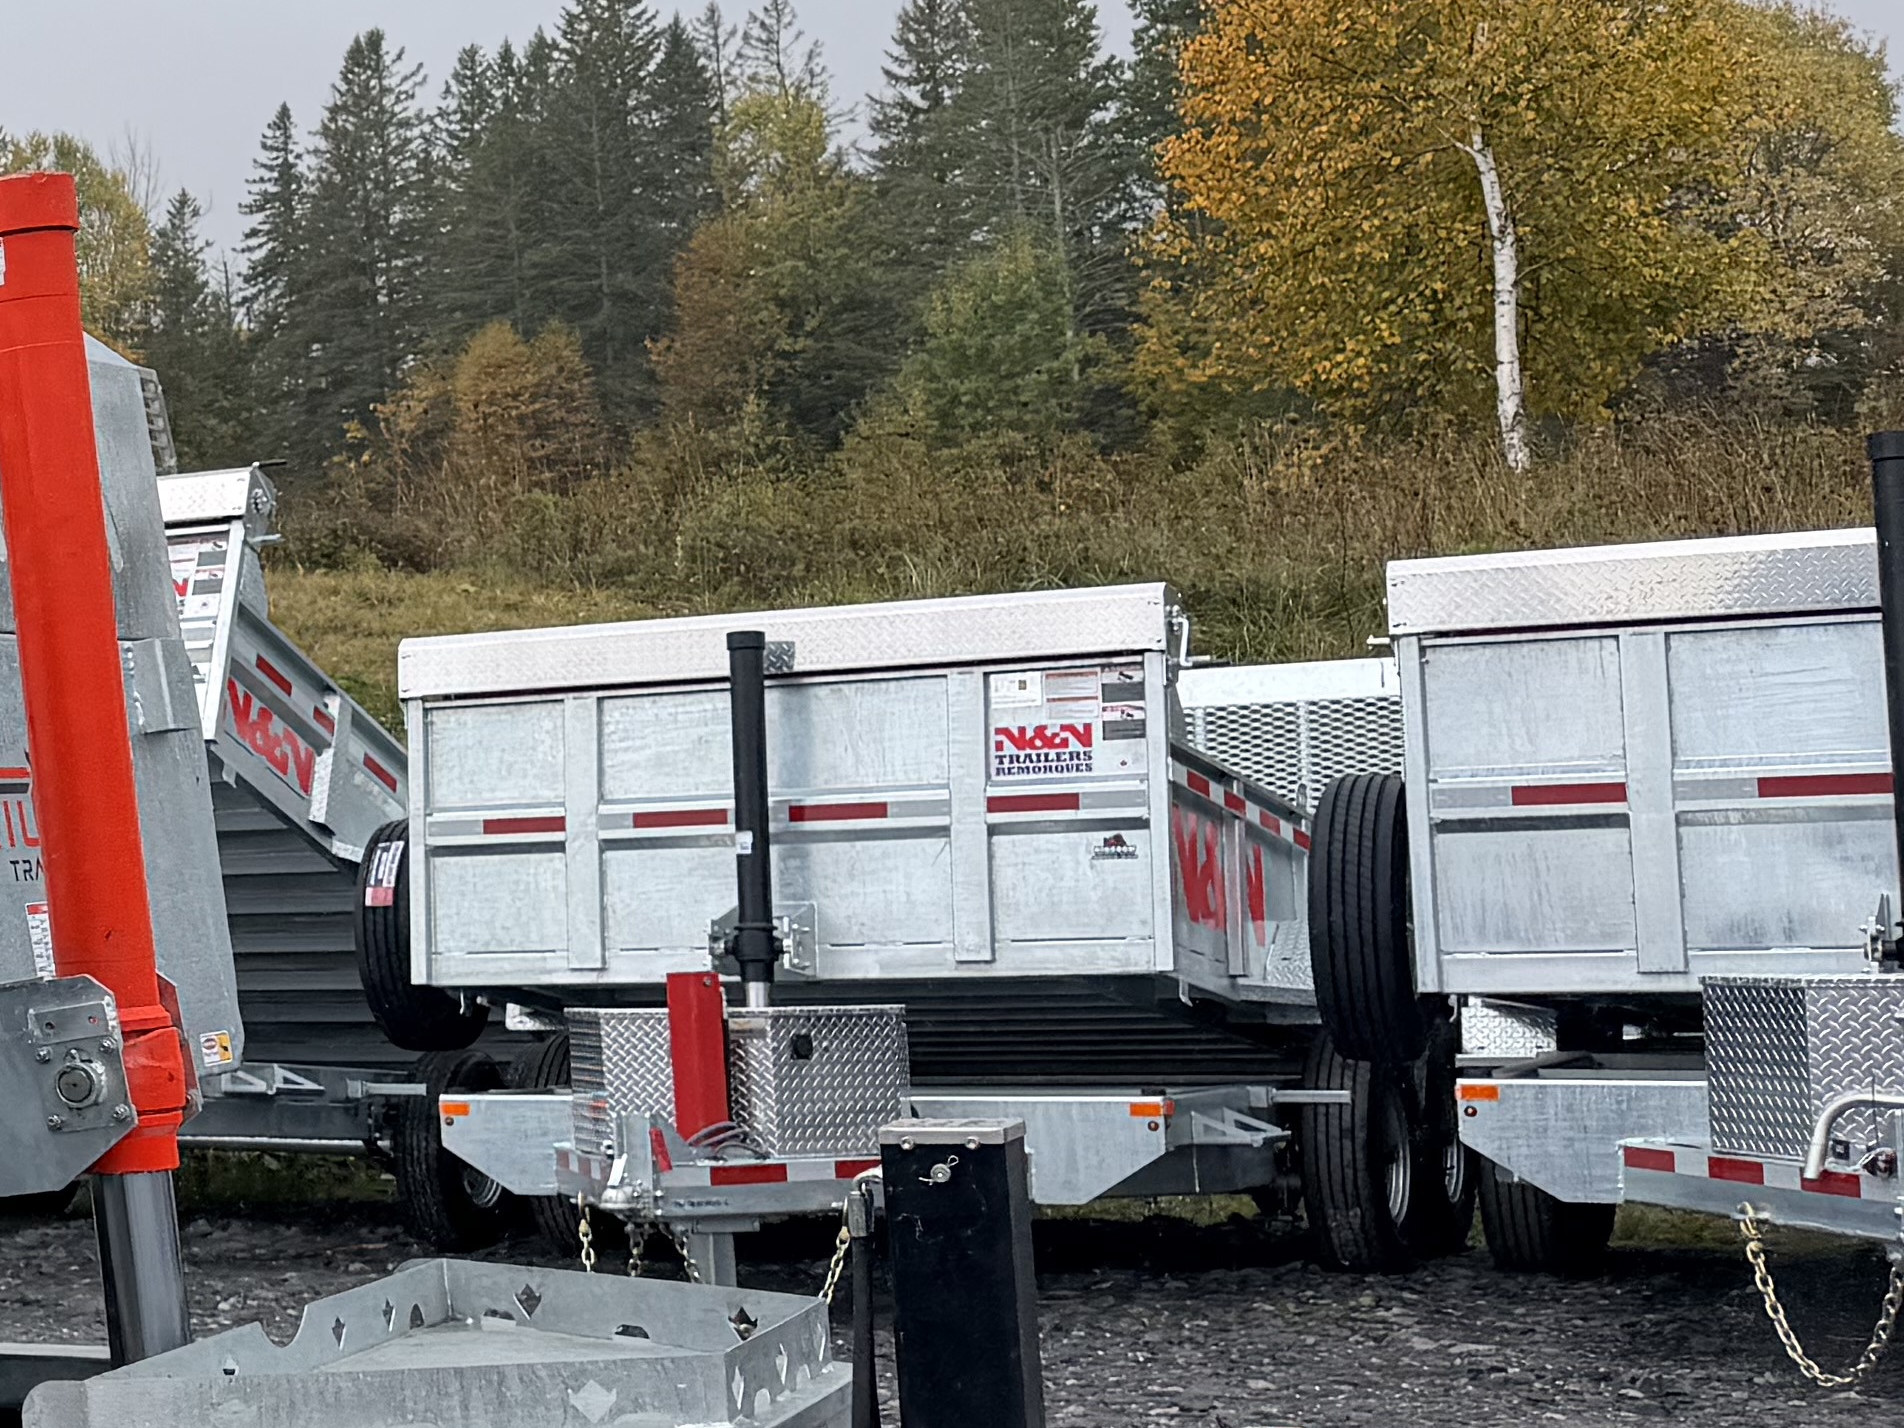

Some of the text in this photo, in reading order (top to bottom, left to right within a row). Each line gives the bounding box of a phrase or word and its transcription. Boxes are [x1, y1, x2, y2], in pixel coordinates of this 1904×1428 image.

[994, 723, 1094, 752] N&N
[994, 751, 1093, 765] TRAILERS
[995, 763, 1093, 777] REMORQUES
